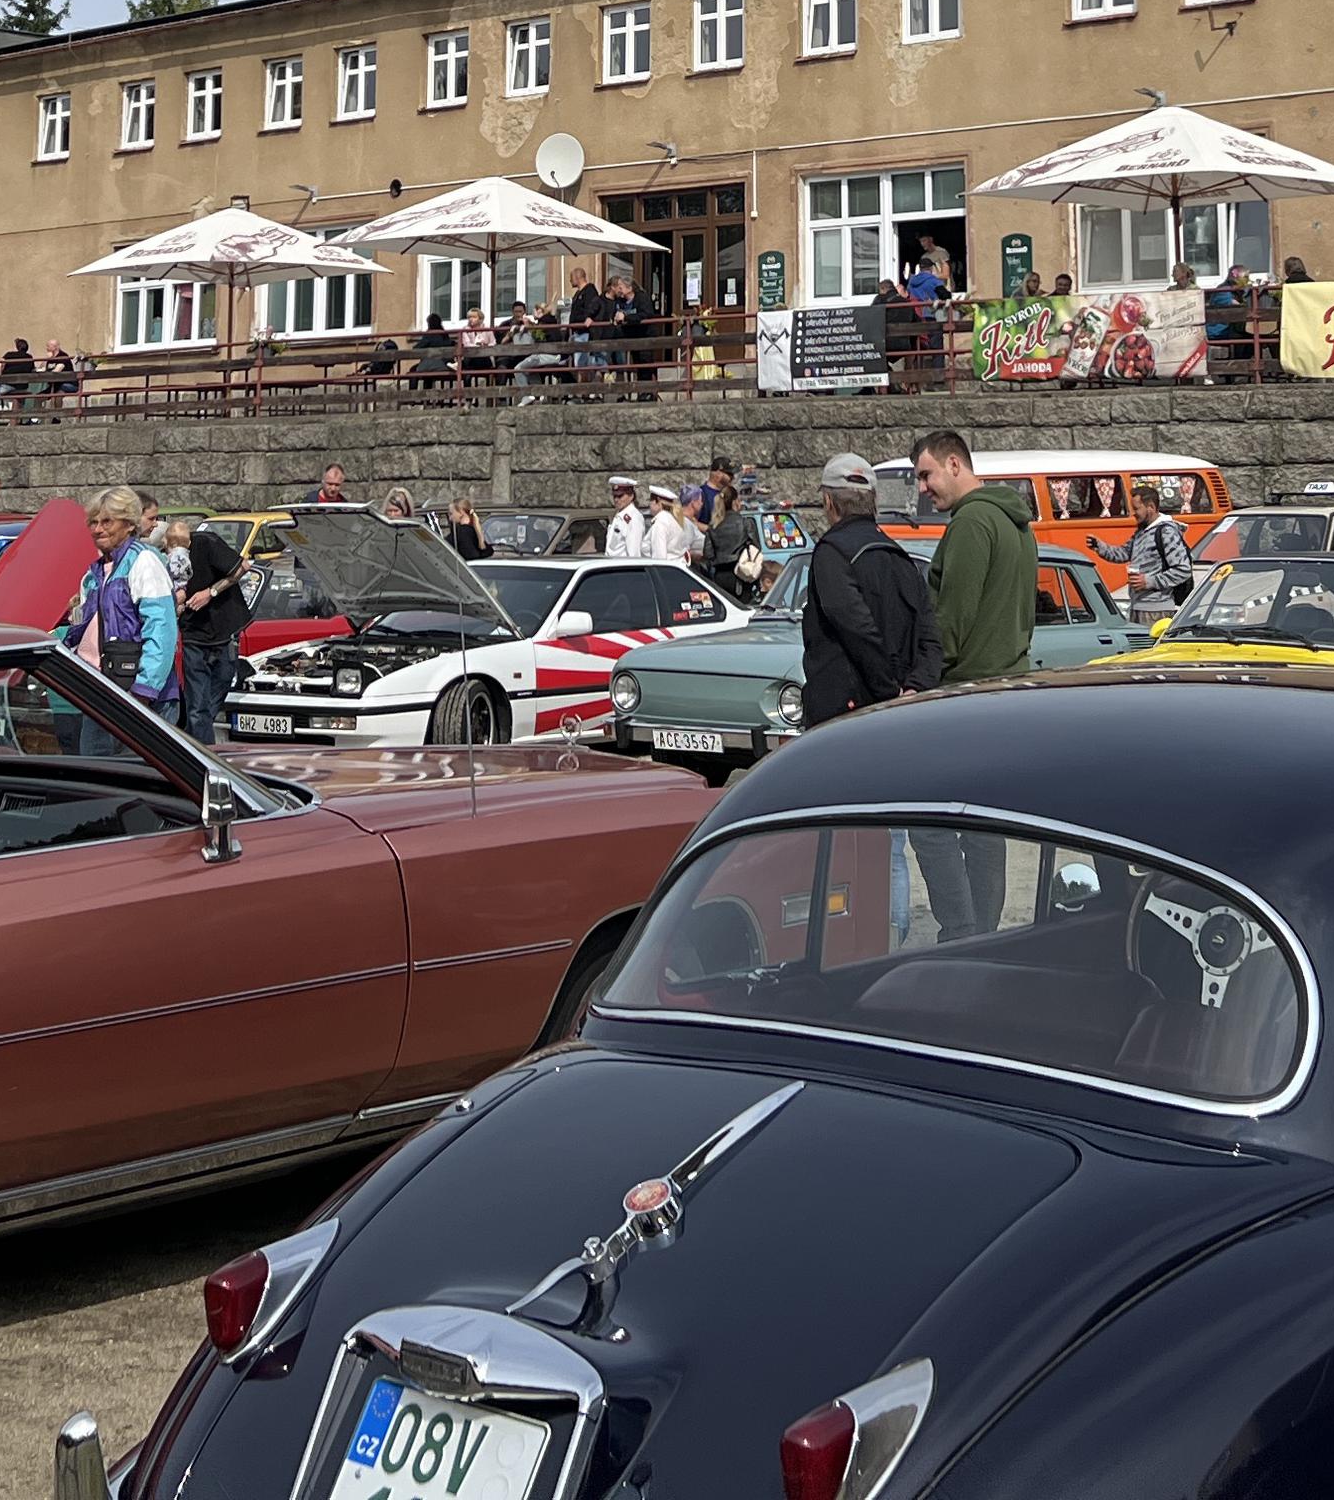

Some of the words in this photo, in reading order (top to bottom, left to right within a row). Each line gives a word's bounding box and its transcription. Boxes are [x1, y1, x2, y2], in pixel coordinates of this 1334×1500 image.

[1115, 159, 1190, 172] BERNARD
[1226, 152, 1317, 171] BERNARD
[435, 221, 491, 230] BERNARD
[524, 215, 604, 233] BERNARD
[1004, 302, 1042, 328] SYROB
[979, 307, 1052, 381] Kitl
[1011, 363, 1053, 374] JAHODA
[1309, 483, 1328, 491] TAXI
[239, 716, 257, 731] 6H2
[263, 717, 288, 733] 4983
[355, 1434, 380, 1459] CZ
[381, 1402, 492, 1496] 08V
